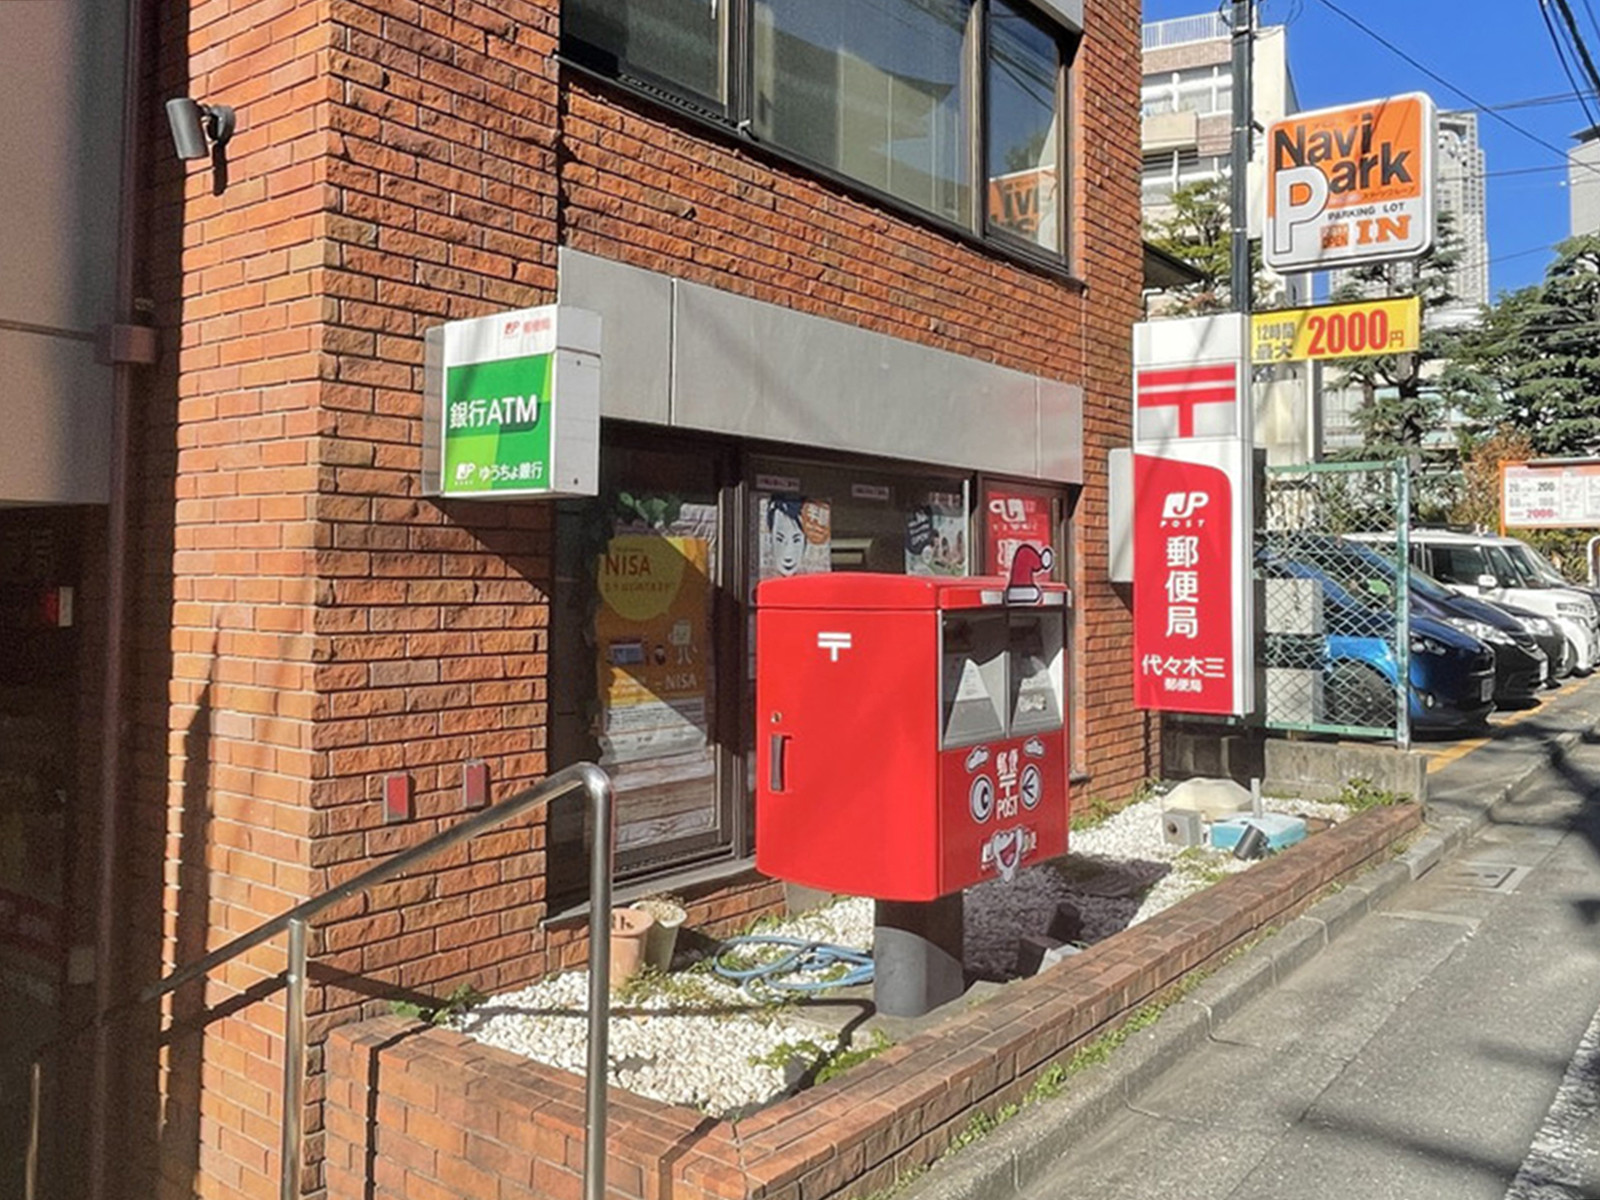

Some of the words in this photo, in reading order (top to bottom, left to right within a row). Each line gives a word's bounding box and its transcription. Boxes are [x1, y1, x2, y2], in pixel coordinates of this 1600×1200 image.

[1274, 112, 1374, 170] Navi
[1274, 142, 1413, 255] Park
[1327, 206, 1376, 221] PARKING
[1382, 201, 1405, 214] LOT
[1356, 214, 1411, 245] IN
[1256, 341, 1293, 360] 最大
[450, 394, 537, 429] 銀行ATM
[479, 460, 544, 482] ゆうちょ銀行
[1159, 518, 1206, 528] POST
[604, 554, 652, 576] NISA
[1165, 535, 1200, 640] 郵便局
[1141, 653, 1227, 679] 代々木三
[996, 795, 1019, 820] POST
